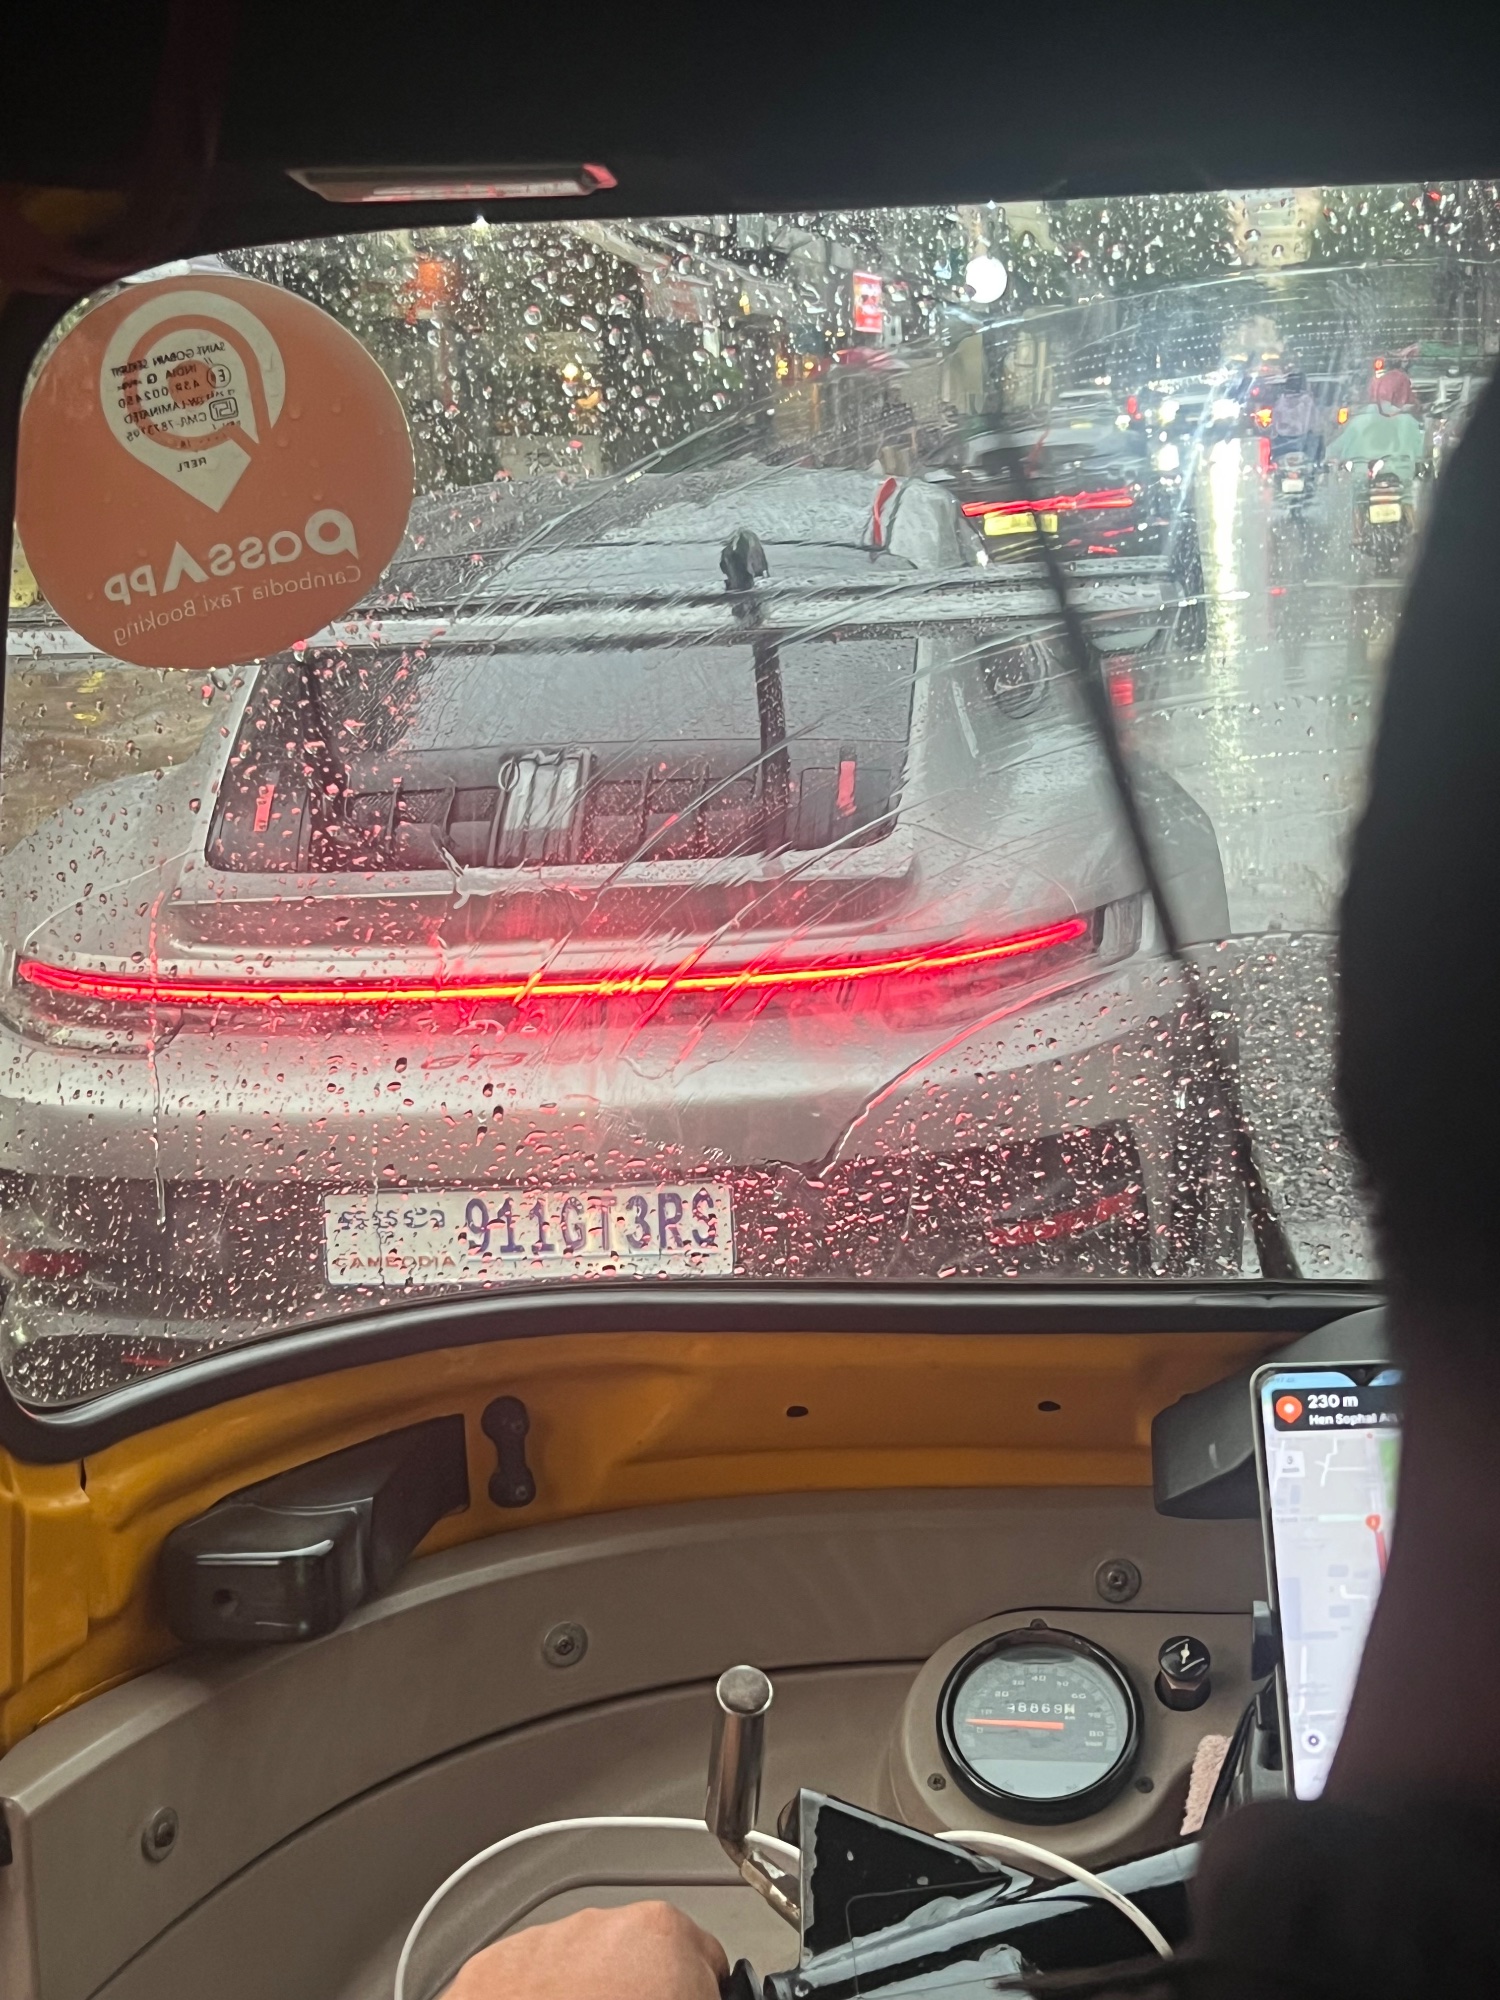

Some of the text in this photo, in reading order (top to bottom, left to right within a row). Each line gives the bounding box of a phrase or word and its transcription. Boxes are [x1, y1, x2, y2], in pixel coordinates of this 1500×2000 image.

[465, 1193, 717, 1254] 911GT3RS
[1307, 1394, 1359, 1409] 230 m
